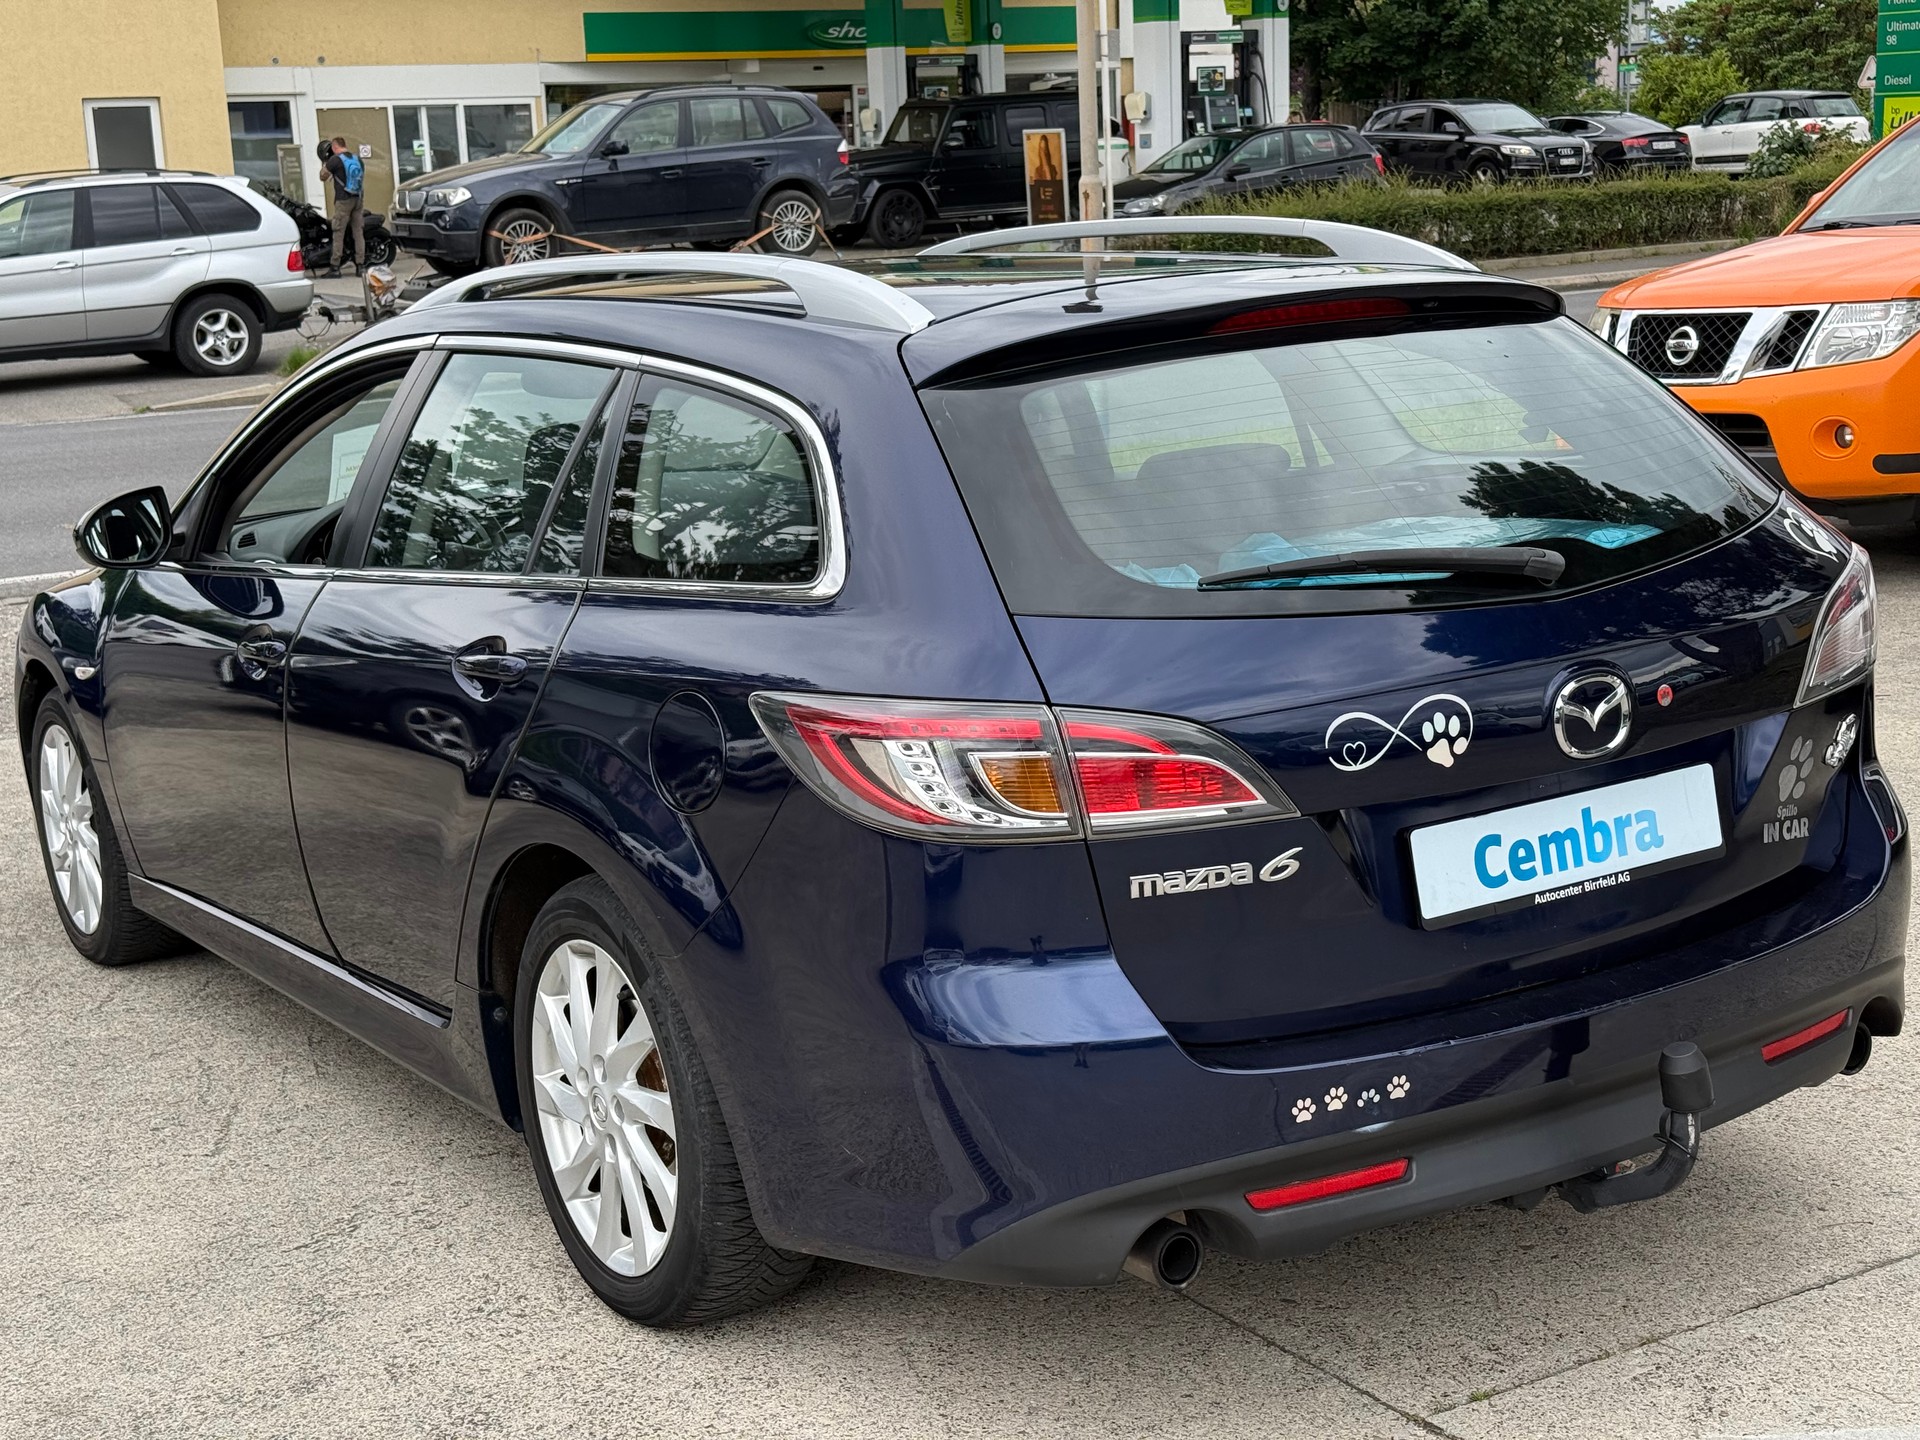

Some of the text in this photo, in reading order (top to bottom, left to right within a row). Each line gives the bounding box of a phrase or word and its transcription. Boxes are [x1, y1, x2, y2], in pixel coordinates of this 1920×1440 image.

[1886, 21, 1920, 32] Ultimat
[1886, 35, 1897, 45] 98
[1884, 75, 1912, 86] Diesel
[1891, 106, 1900, 116] bp
[1763, 817, 1809, 843] IN CAR
[1474, 806, 1664, 889] Cembra
[1259, 846, 1303, 882] 6
[1534, 871, 1631, 904] Autocenter Birrfeld AG
